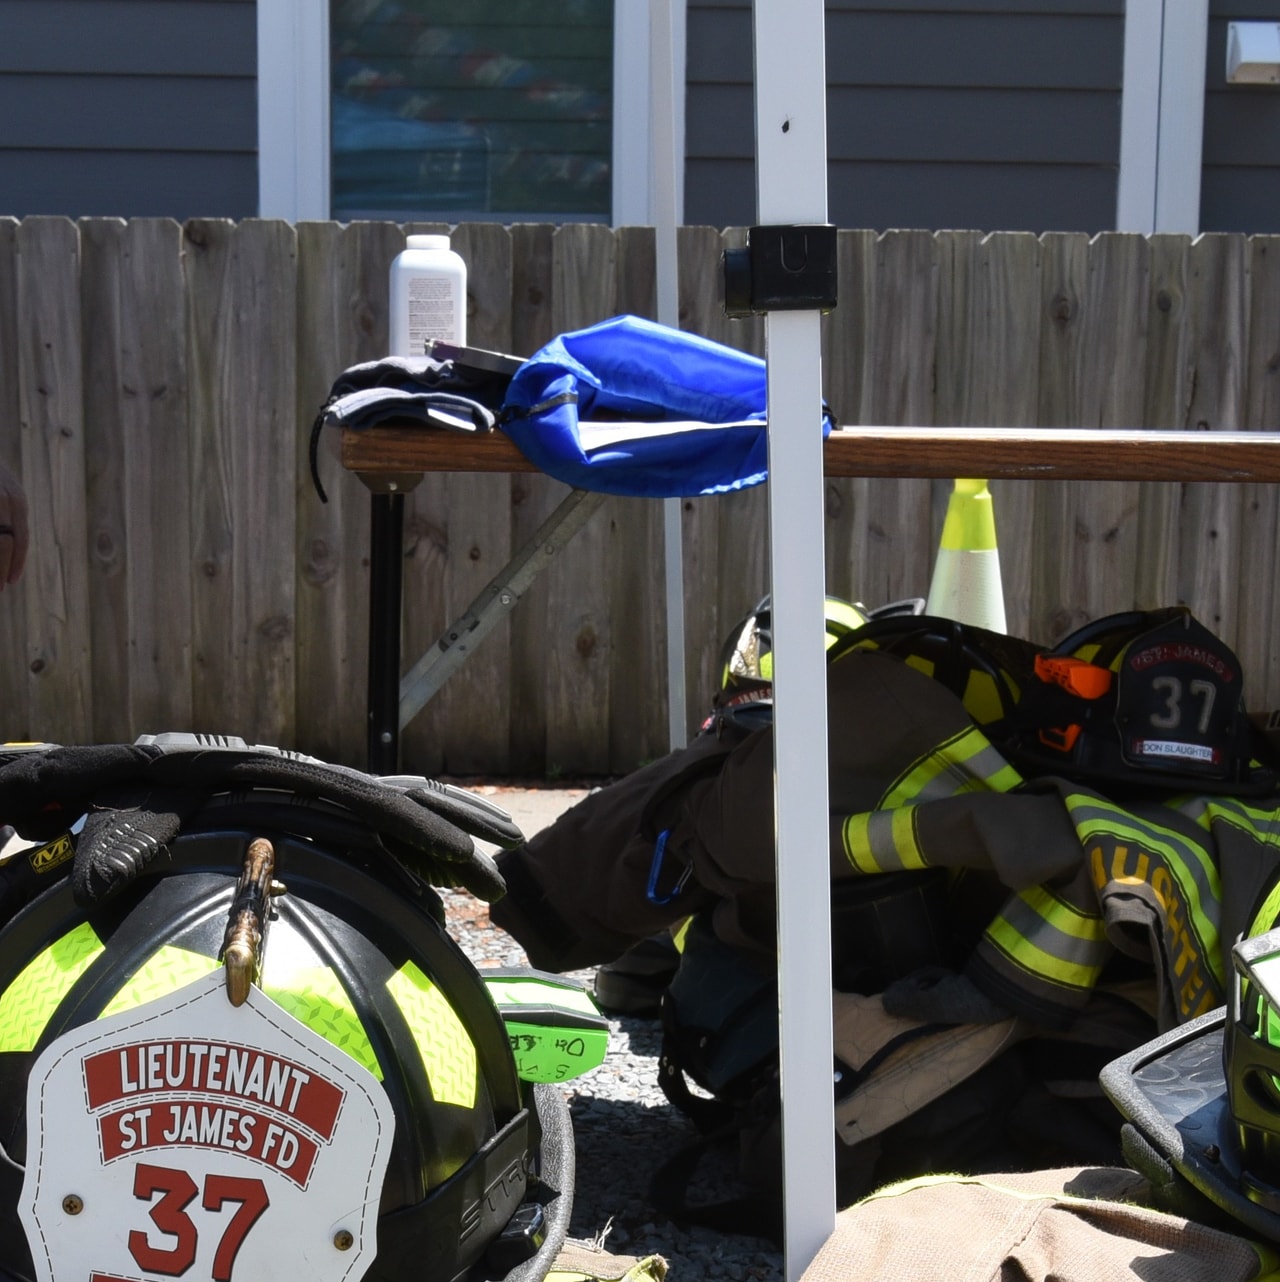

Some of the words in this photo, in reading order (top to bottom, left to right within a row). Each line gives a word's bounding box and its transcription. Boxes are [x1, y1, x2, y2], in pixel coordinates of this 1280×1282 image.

[1150, 676, 1217, 734] 37
[1165, 744, 1212, 759] SLAUGHTER
[120, 1044, 310, 1113] LIEUTENANT
[119, 1111, 150, 1149] ST
[163, 1107, 256, 1153] JAMES
[263, 1131, 300, 1170] FD
[127, 1163, 270, 1282] 37
